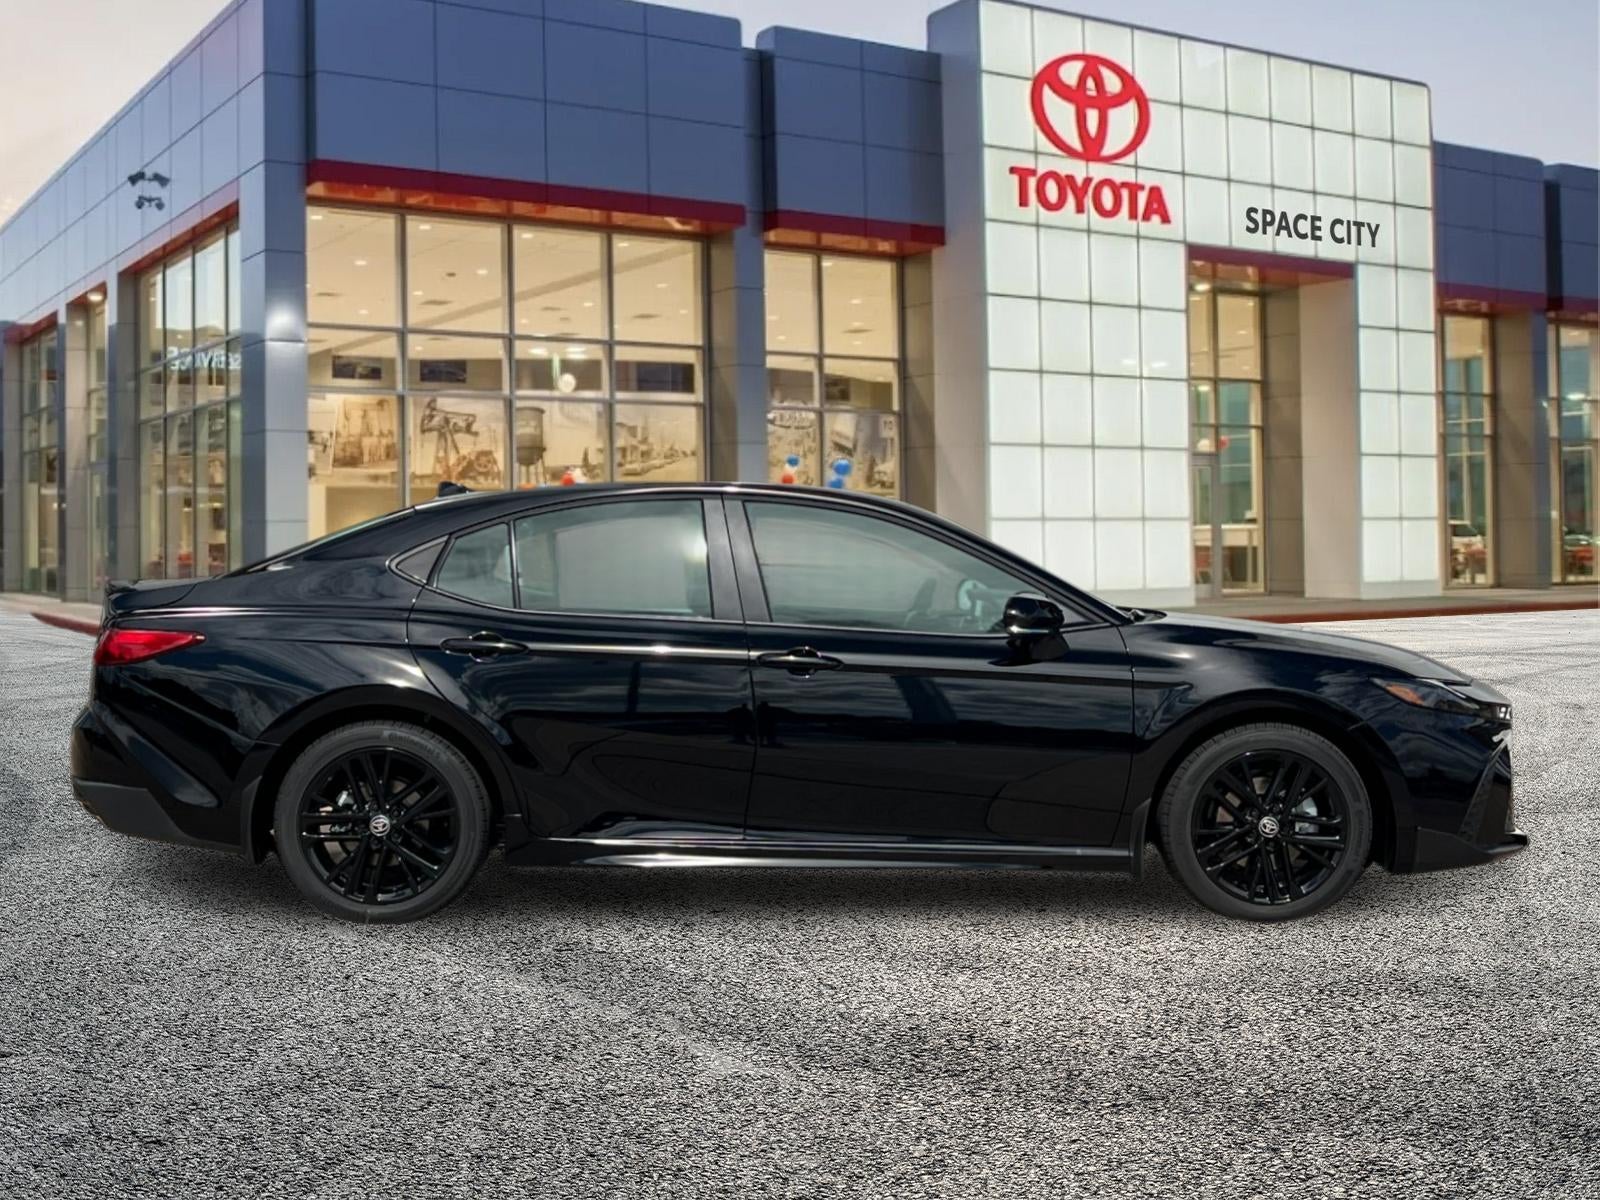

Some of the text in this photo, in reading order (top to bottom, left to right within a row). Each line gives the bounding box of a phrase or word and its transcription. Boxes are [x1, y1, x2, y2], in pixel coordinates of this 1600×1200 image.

[1009, 166, 1171, 224] TOYOTA
[1245, 206, 1380, 247] SPACE CITY
